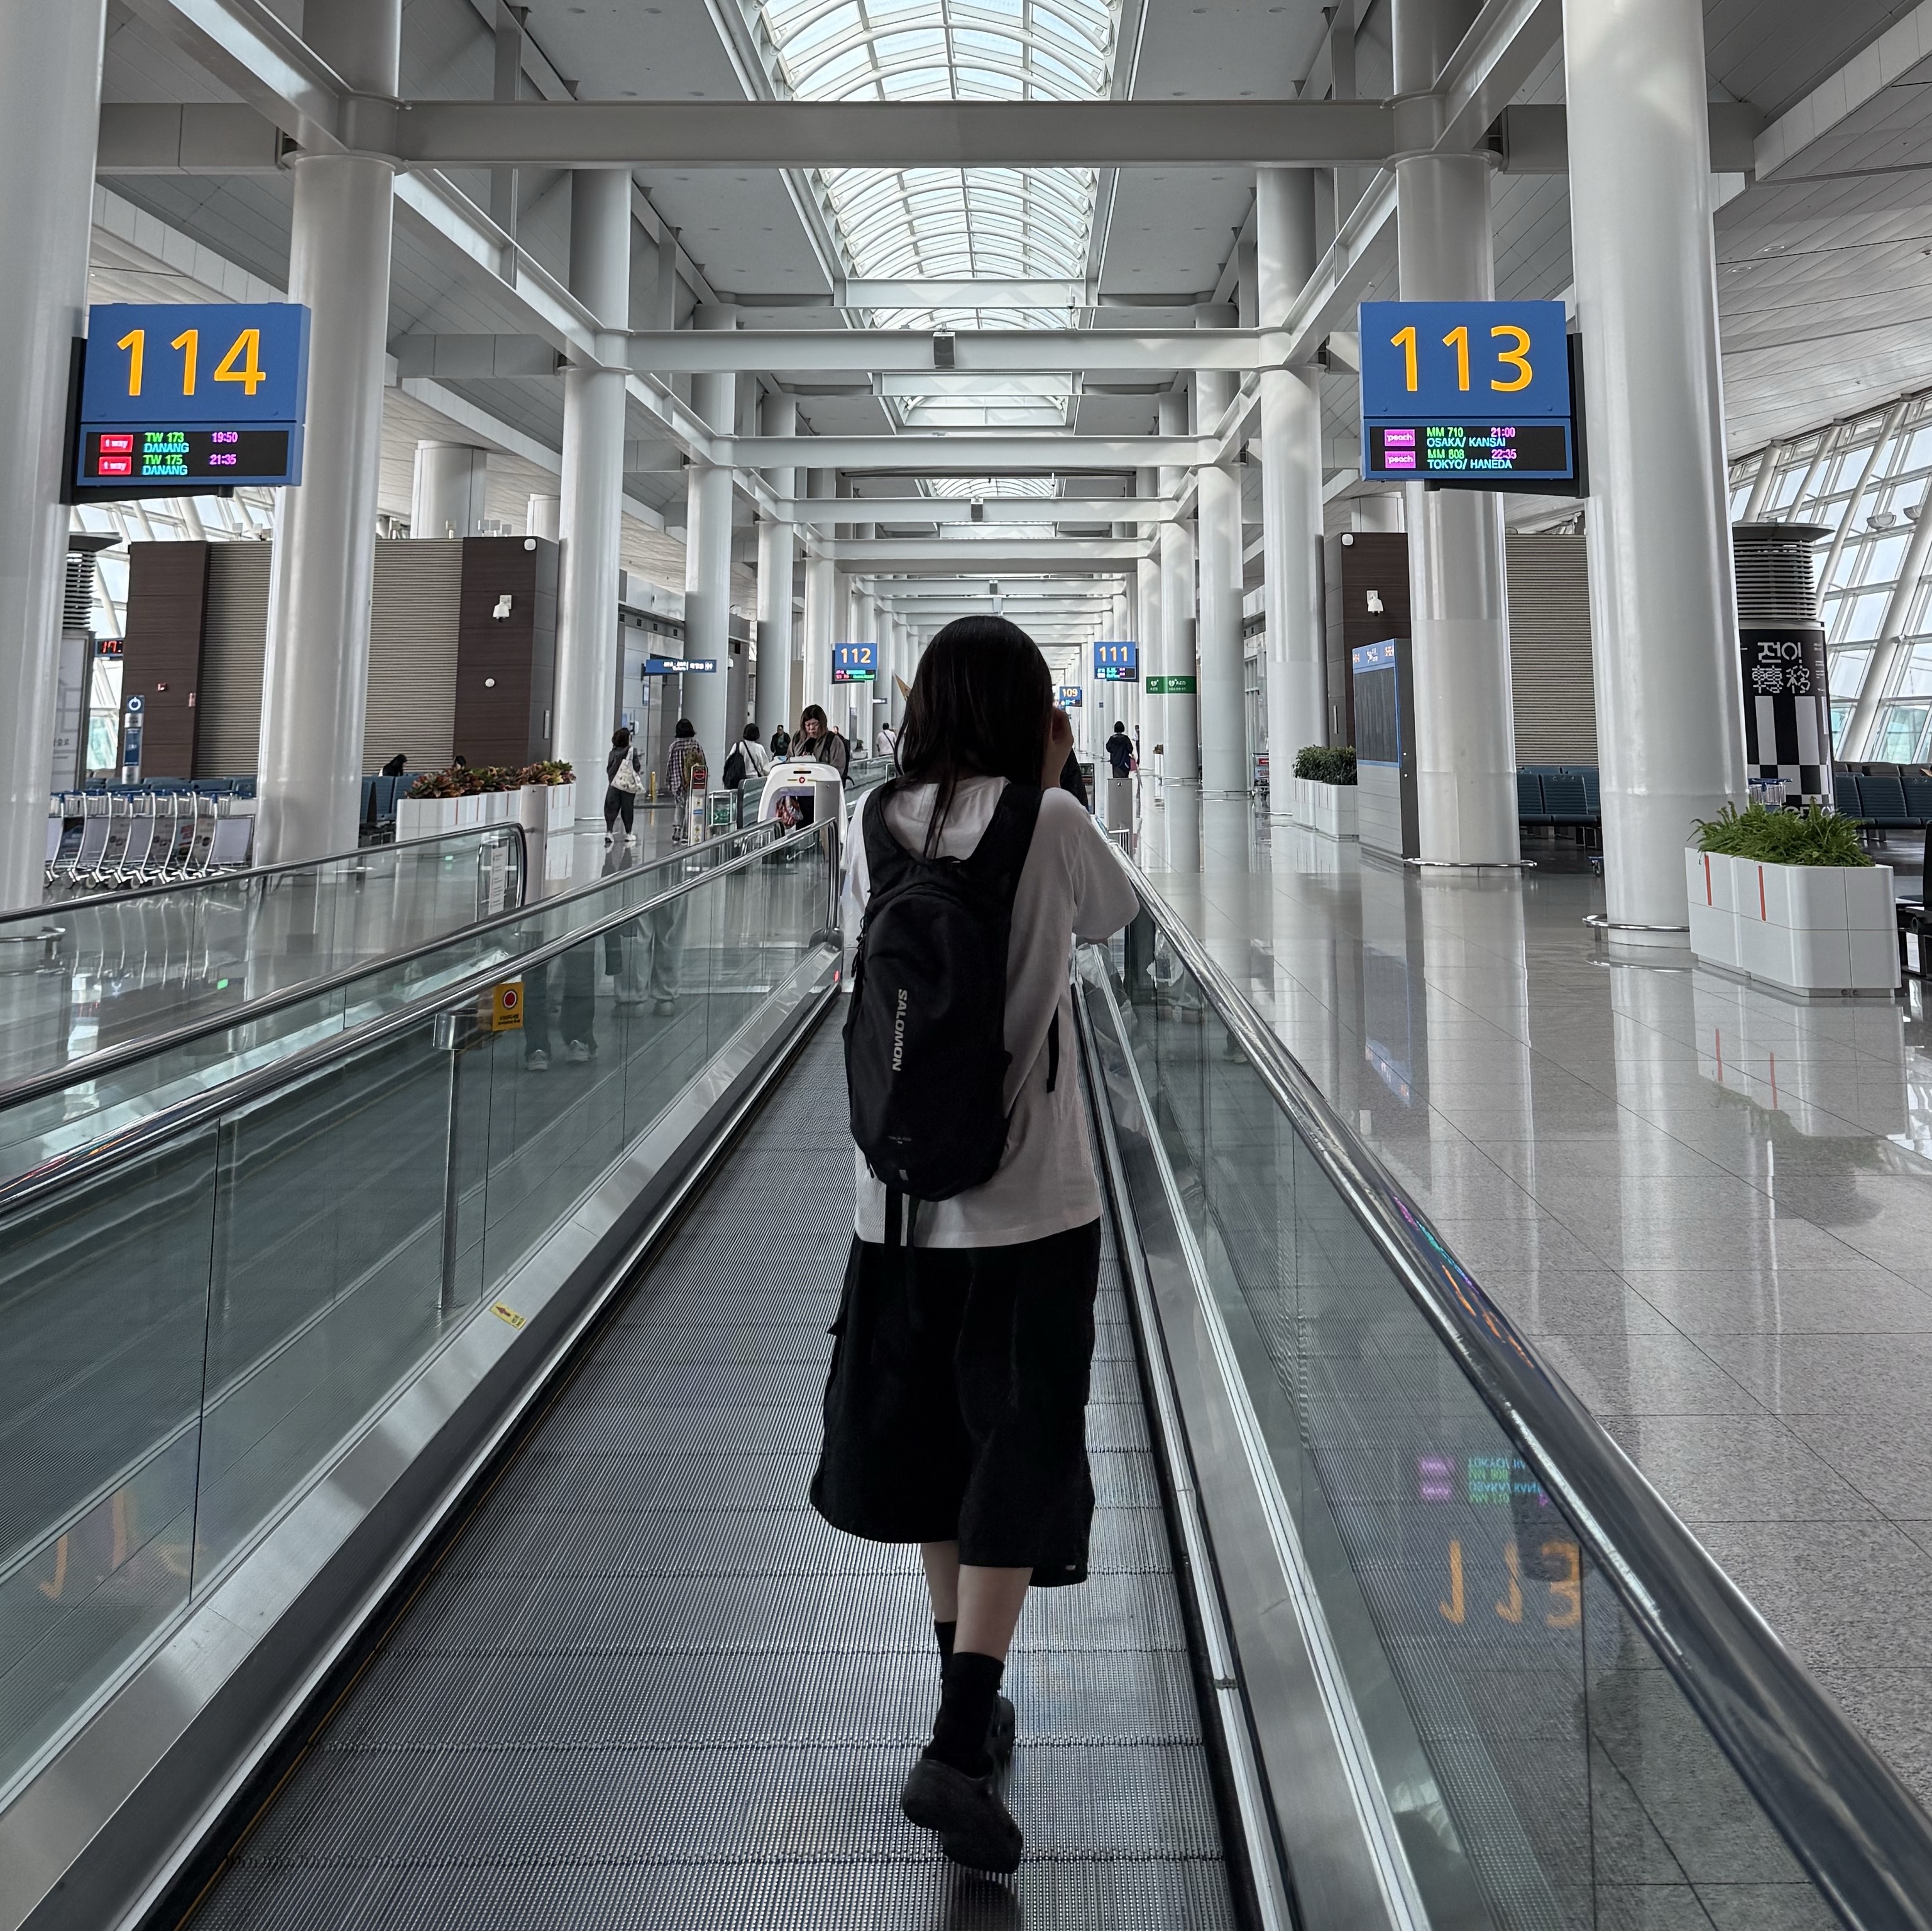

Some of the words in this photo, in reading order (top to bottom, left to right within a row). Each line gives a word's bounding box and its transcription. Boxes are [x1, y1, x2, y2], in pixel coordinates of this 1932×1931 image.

[117, 329, 266, 397] 114
[1390, 325, 1534, 392] 113
[144, 432, 163, 442] TW
[167, 432, 185, 442] 173
[212, 432, 238, 443] 19:50
[1386, 433, 1413, 442] peach
[1426, 427, 1445, 437] MM
[1447, 427, 1464, 437] 710
[1490, 427, 1516, 438] 21:00
[143, 442, 189, 453] DANANG
[1469, 437, 1507, 447] KANSAI
[1388, 454, 1413, 464] peach
[1427, 449, 1445, 459] MM
[1448, 449, 1465, 459] 808
[1491, 449, 1517, 459] 22:35
[143, 454, 163, 465] TW
[165, 454, 184, 465] 175
[209, 454, 238, 466] 21:35
[1470, 459, 1513, 469] HANEDA
[142, 465, 188, 476] DANANG
[102, 641, 123, 653] 17:
[841, 648, 871, 664] 112
[1099, 646, 1128, 662] 111
[1062, 688, 1078, 697] 109
[892, 988, 908, 1071] SALOMON
